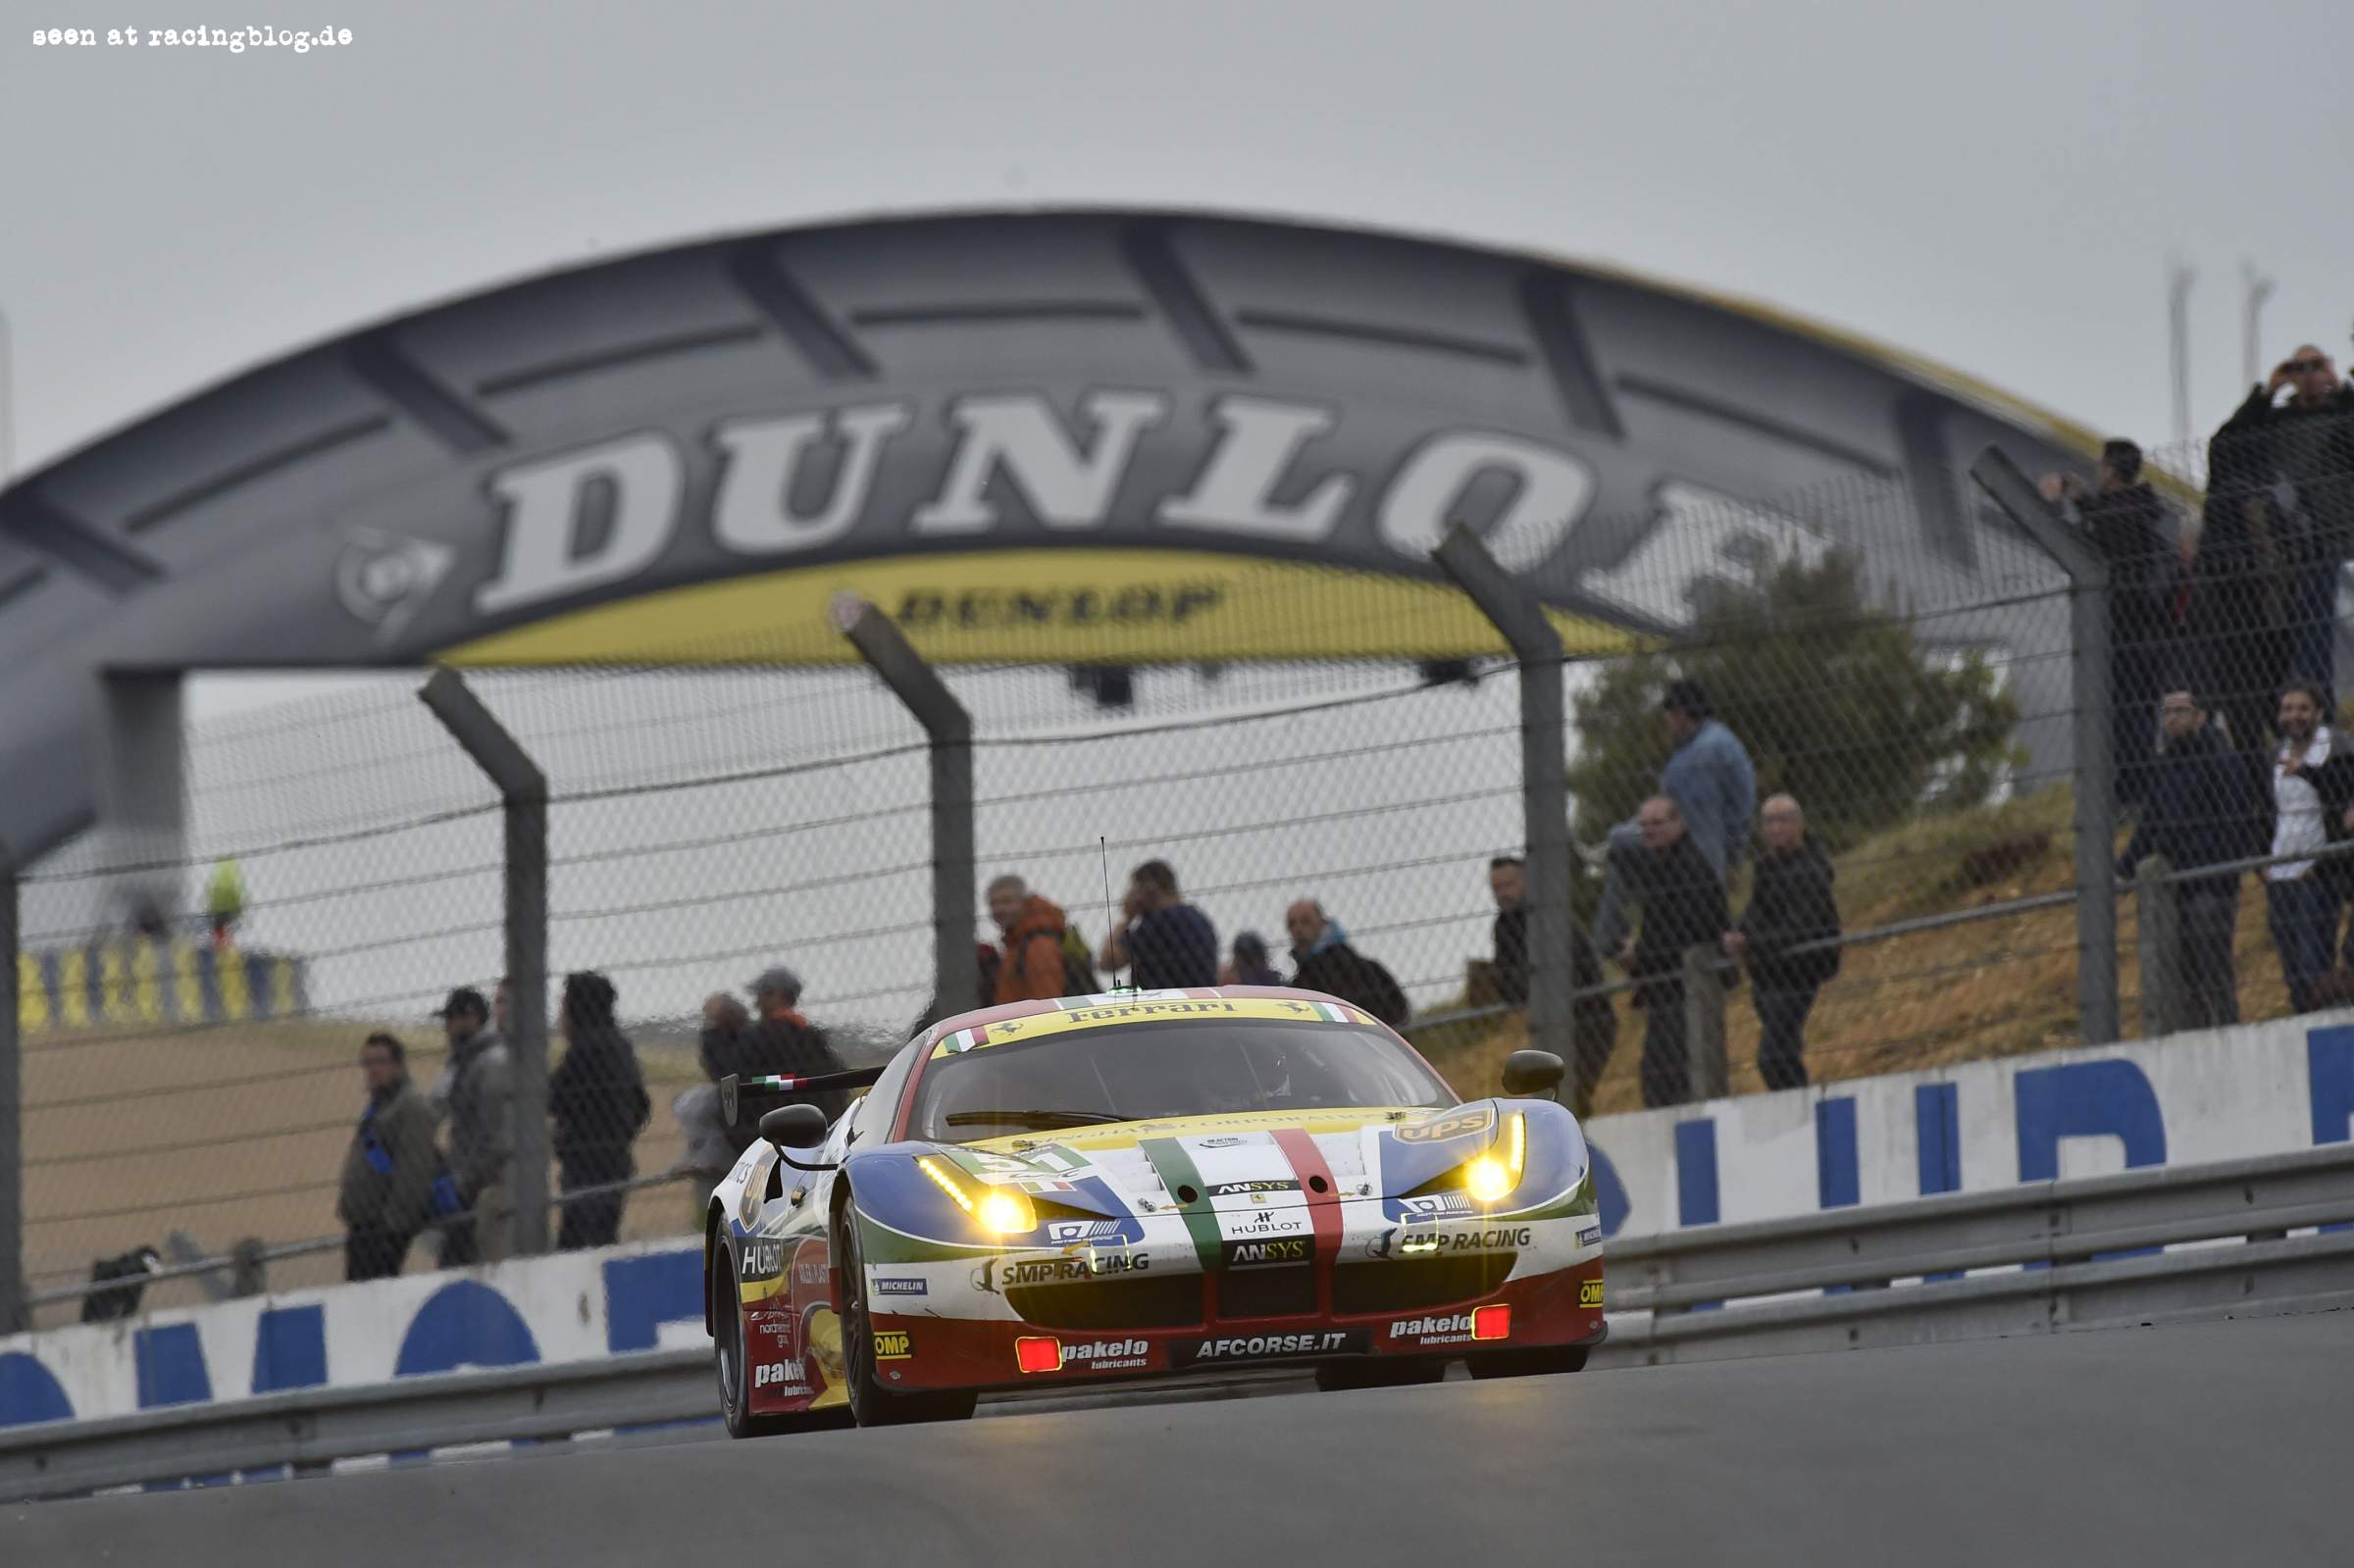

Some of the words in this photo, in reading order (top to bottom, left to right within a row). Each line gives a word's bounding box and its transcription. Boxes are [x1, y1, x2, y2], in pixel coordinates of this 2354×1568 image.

[475, 392, 1832, 628] DUNLOP
[897, 583, 1224, 628] DUNLOP
[1066, 1001, 1238, 1023] Ferrari
[1403, 1115, 1485, 1138] ups
[1218, 1181, 1289, 1194] ANSYS
[1231, 1222, 1302, 1235] HUBLOT
[1452, 1228, 1531, 1250] RACING
[1232, 1239, 1305, 1262] ANSYS
[1001, 1263, 1053, 1285] SMP
[1058, 1252, 1150, 1280] RACING
[881, 1281, 924, 1291] MICHELIN
[1390, 1314, 1472, 1339] pakelo
[875, 1335, 909, 1354] OMP
[1196, 1333, 1347, 1358] AFCORSE.IT
[1420, 1334, 1472, 1345] lubricants
[1062, 1339, 1149, 1363] pakelo
[1091, 1358, 1147, 1370] lubricants
